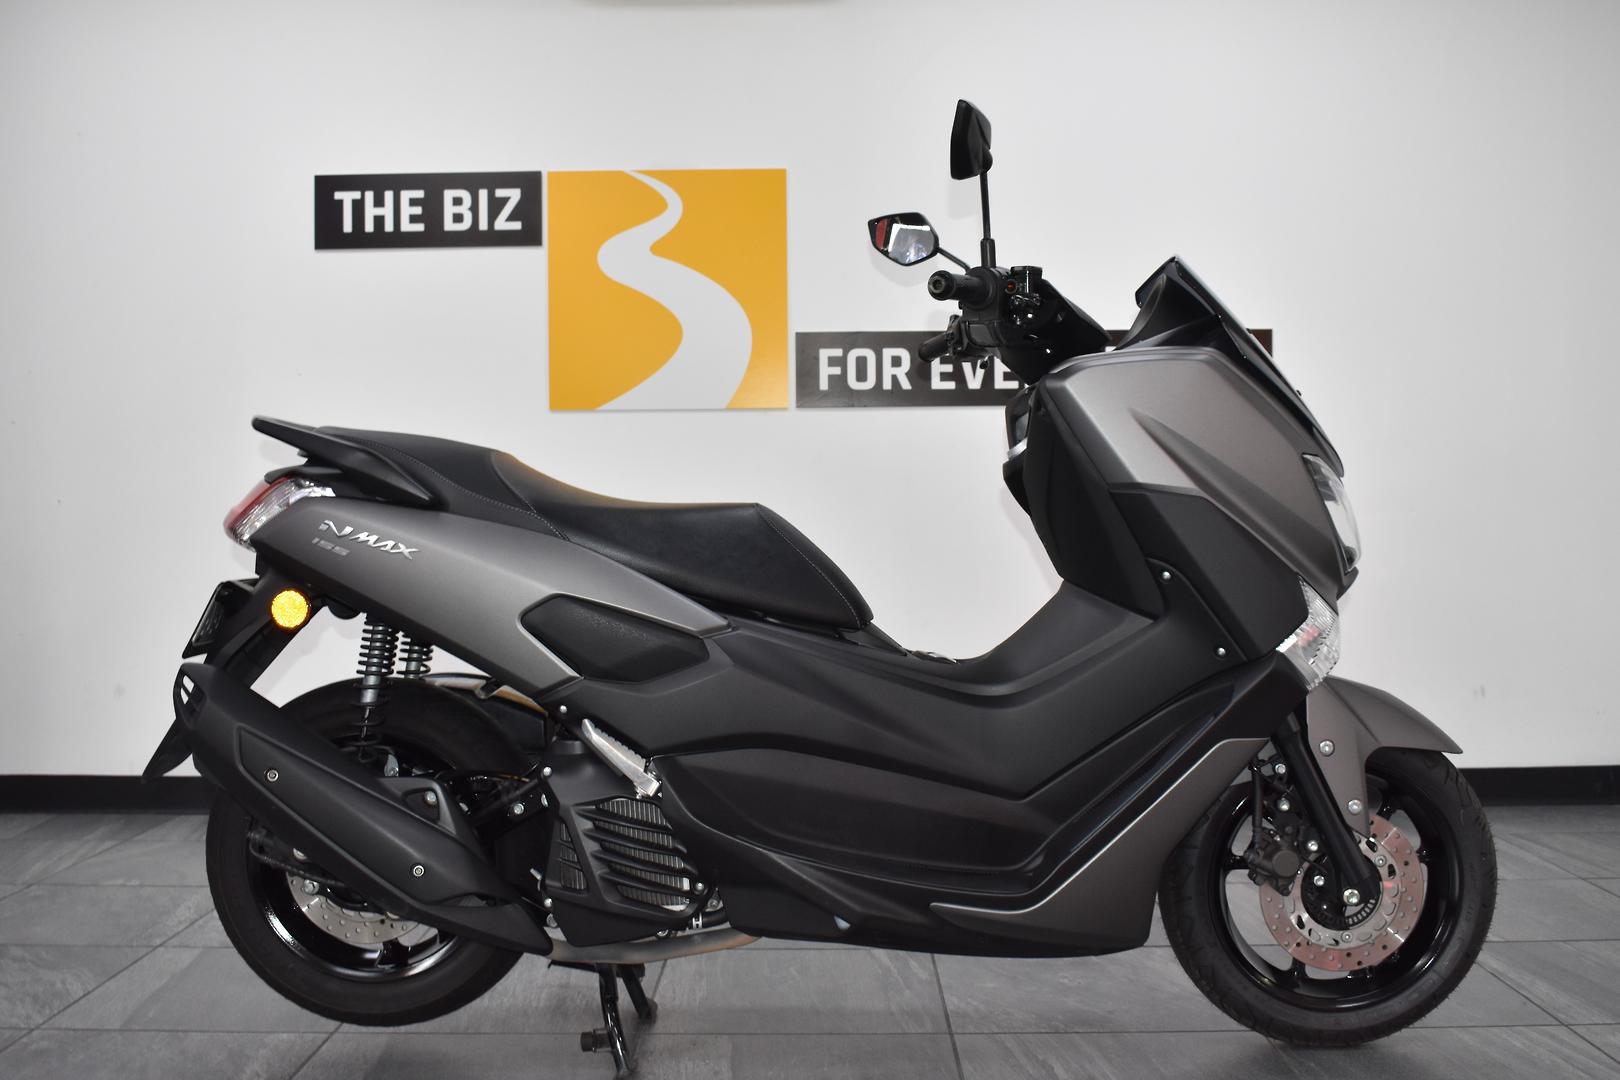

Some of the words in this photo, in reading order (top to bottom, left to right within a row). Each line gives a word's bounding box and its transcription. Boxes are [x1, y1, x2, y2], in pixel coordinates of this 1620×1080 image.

[333, 189, 425, 233] THE
[443, 187, 523, 232] BIZ
[818, 347, 912, 391] FOR
[930, 355, 1030, 390] EVE
[318, 519, 421, 560] NMAX
